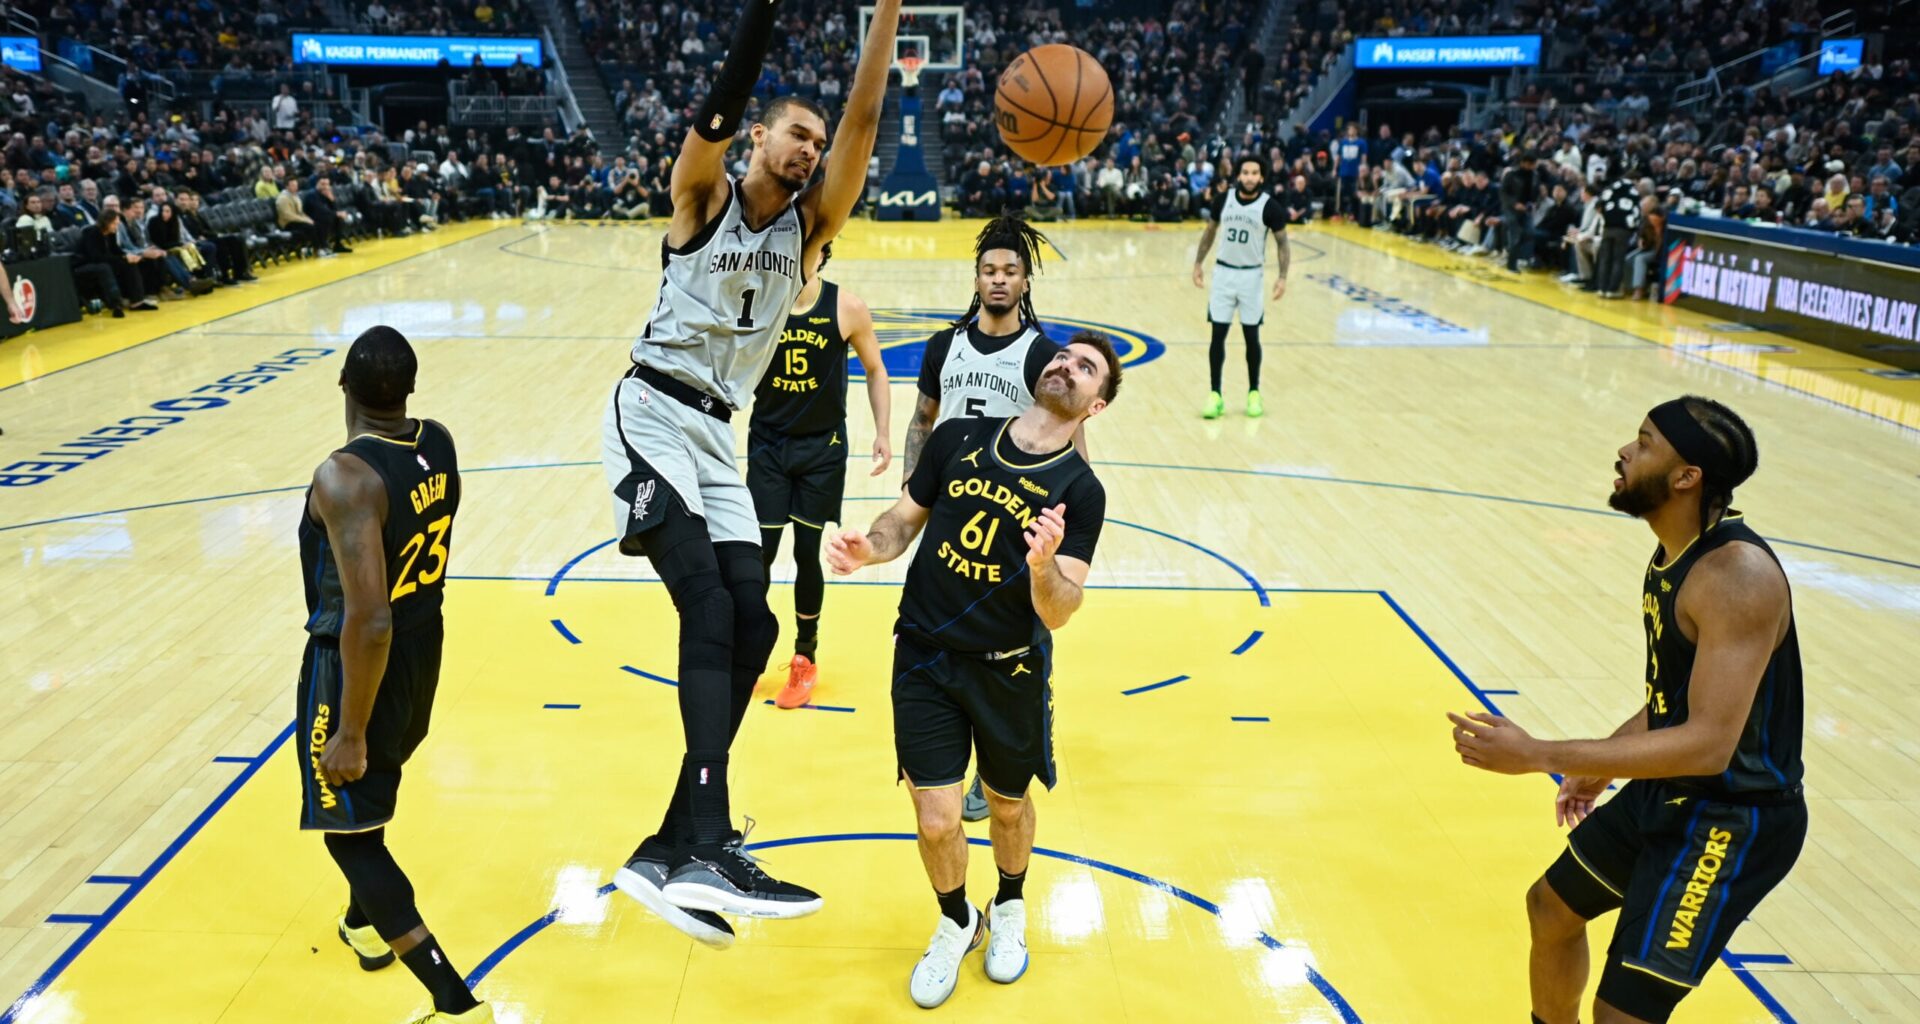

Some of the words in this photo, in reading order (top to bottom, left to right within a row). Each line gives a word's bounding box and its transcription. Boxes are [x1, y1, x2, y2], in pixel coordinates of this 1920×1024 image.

[326, 46, 363, 59] KAISER
[1396, 48, 1436, 63] KAISER
[1228, 228, 1248, 243] 30
[710, 253, 741, 273] SAN
[1752, 258, 1773, 274] BY
[737, 289, 755, 327] 1
[1776, 276, 1799, 312] NBA
[1800, 281, 1872, 329] CELEBRATES
[1872, 296, 1917, 340] BLACK
[779, 329, 828, 349] OLDEN
[190, 348, 336, 394] CHASE
[785, 348, 808, 375] 15
[773, 377, 818, 392] STATE
[943, 373, 963, 395] SAN
[965, 371, 1019, 403] ANTONIO
[965, 397, 987, 418] 5
[410, 472, 447, 515] GREEN
[1018, 476, 1049, 499] Rakuten
[948, 477, 1039, 530] GOLDEN
[960, 510, 1000, 557] 61
[390, 515, 451, 602] 23
[938, 541, 1001, 582] STATE
[1665, 826, 1732, 949] WARRIORS
